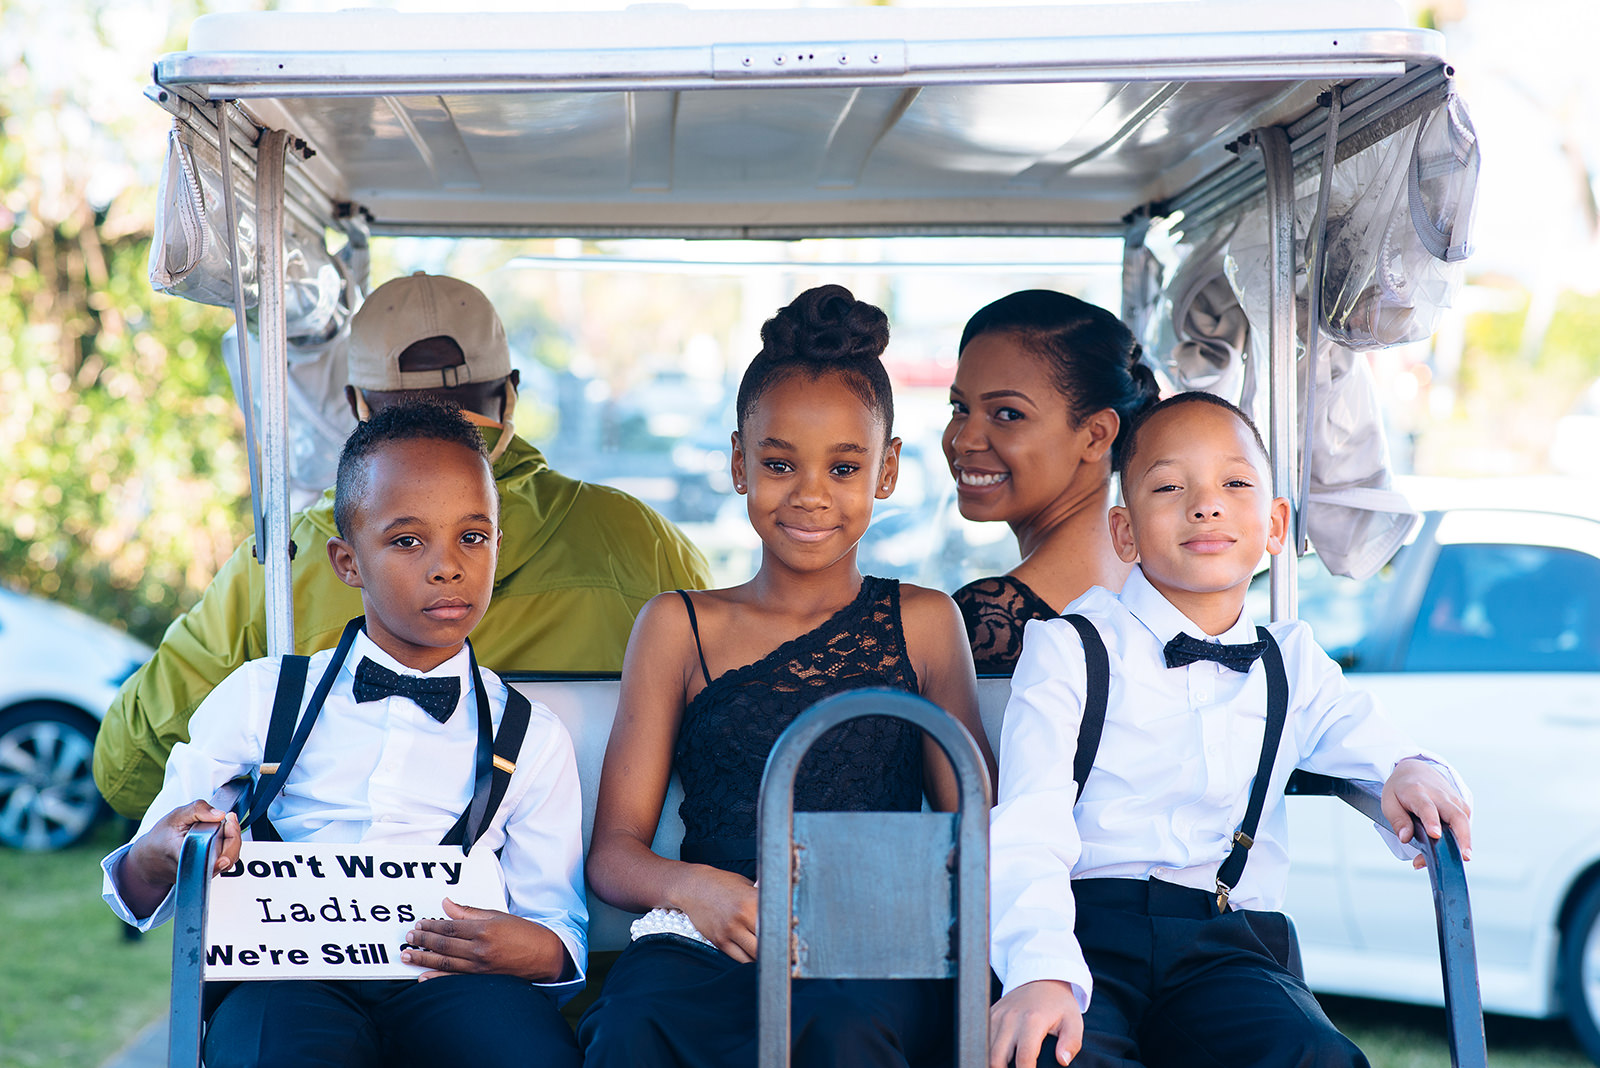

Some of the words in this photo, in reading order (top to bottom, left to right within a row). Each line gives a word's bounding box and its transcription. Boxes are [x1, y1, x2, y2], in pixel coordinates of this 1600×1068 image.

[335, 855, 462, 885] Worry
[206, 944, 309, 966] We're
[322, 943, 389, 965] Still
